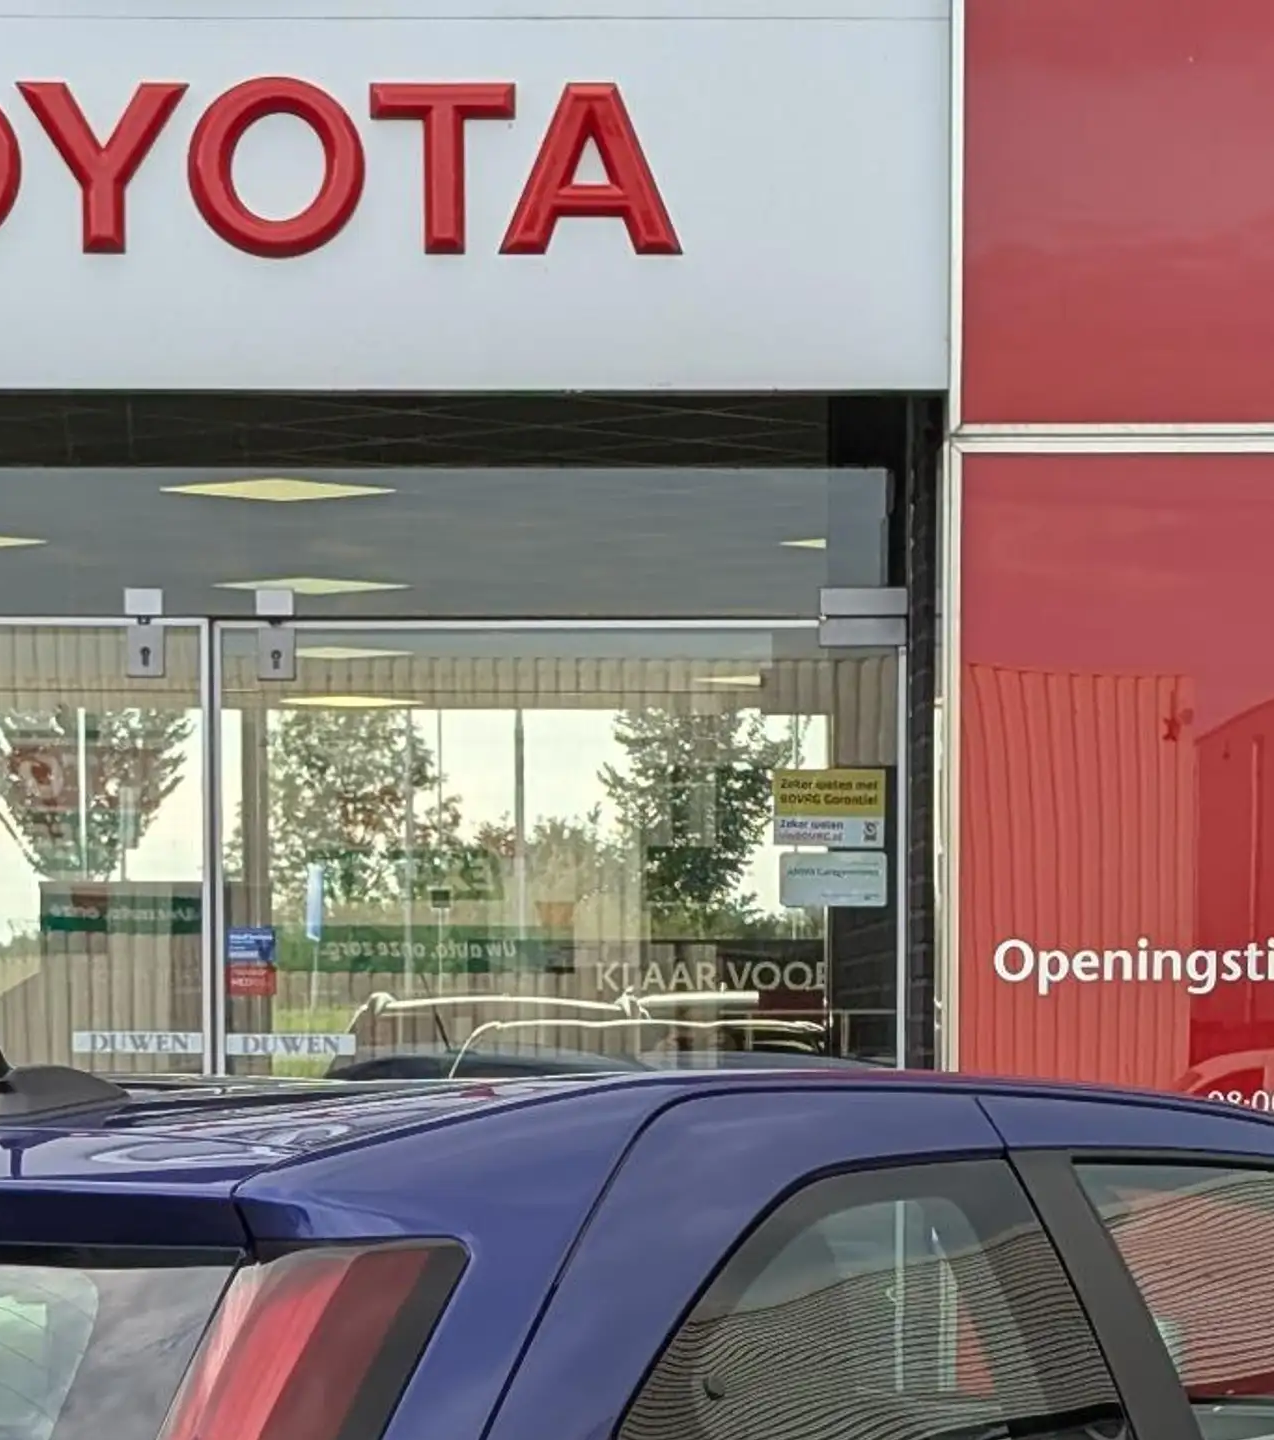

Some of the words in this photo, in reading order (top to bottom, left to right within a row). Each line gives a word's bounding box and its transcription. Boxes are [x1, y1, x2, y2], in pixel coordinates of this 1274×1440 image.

[595, 961, 717, 991] KLAAR
[89, 1032, 189, 1052] DUWEN
[242, 1035, 341, 1054] DUWEN
